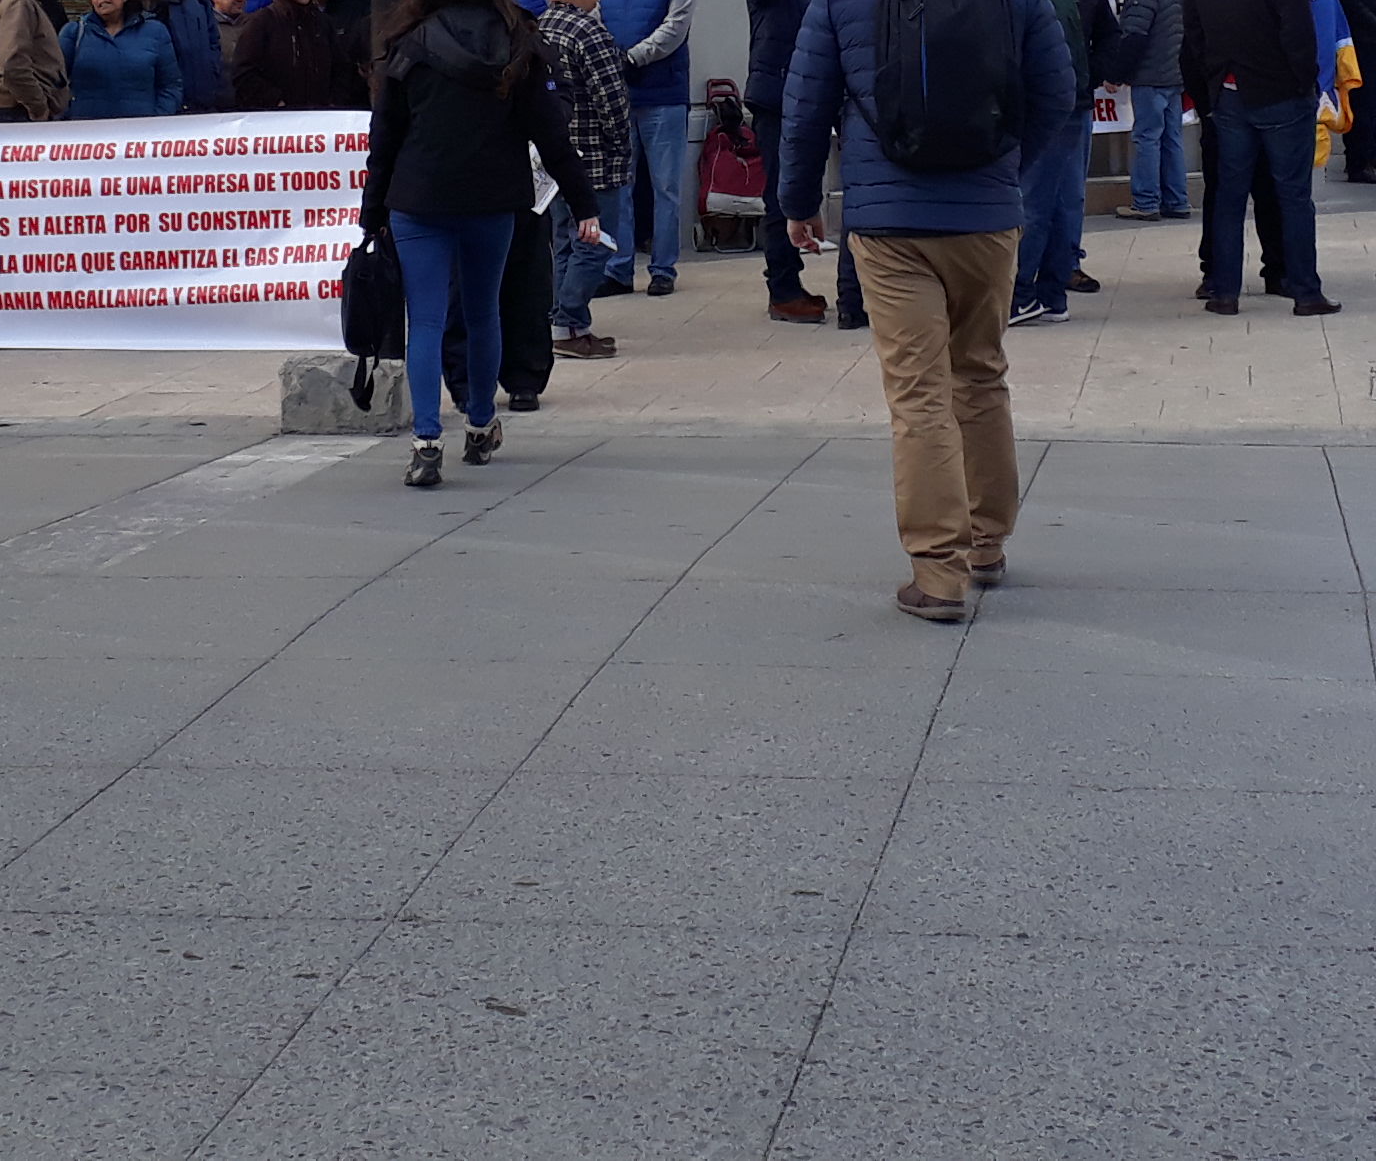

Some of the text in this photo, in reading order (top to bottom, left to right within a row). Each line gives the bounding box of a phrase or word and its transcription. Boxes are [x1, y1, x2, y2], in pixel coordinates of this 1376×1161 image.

[1093, 98, 1118, 122] ER
[0, 144, 47, 163] ENAP
[49, 141, 116, 162] UNIDOS
[124, 141, 147, 160] EN
[152, 137, 209, 159] TODAS
[213, 135, 249, 157] SUS
[252, 133, 327, 155] FILIALES
[334, 131, 370, 153] PAR
[8, 177, 92, 200] HISTORIA
[100, 176, 121, 197] DE
[126, 175, 164, 196] UNA
[166, 172, 251, 195] EMPRESA
[253, 171, 276, 193] DE
[280, 169, 341, 192] TODOS
[349, 169, 370, 190] LO
[17, 216, 40, 237] EN
[43, 213, 107, 236] ALERTA
[114, 213, 151, 233] POR
[158, 211, 184, 233] SU
[187, 208, 292, 232] CONSTANTE
[304, 206, 361, 228] DESPR
[22, 252, 78, 275] UNICA
[81, 251, 115, 274] QUE
[119, 248, 218, 271] GARANTIZA
[222, 247, 239, 268] EL
[244, 246, 279, 267] GAS
[283, 243, 328, 263] PARA
[331, 241, 352, 262] LA
[46, 287, 169, 310] MAGALLANICA
[173, 286, 184, 306] Y
[186, 282, 260, 305] ENERGIA
[262, 280, 311, 301] PARA
